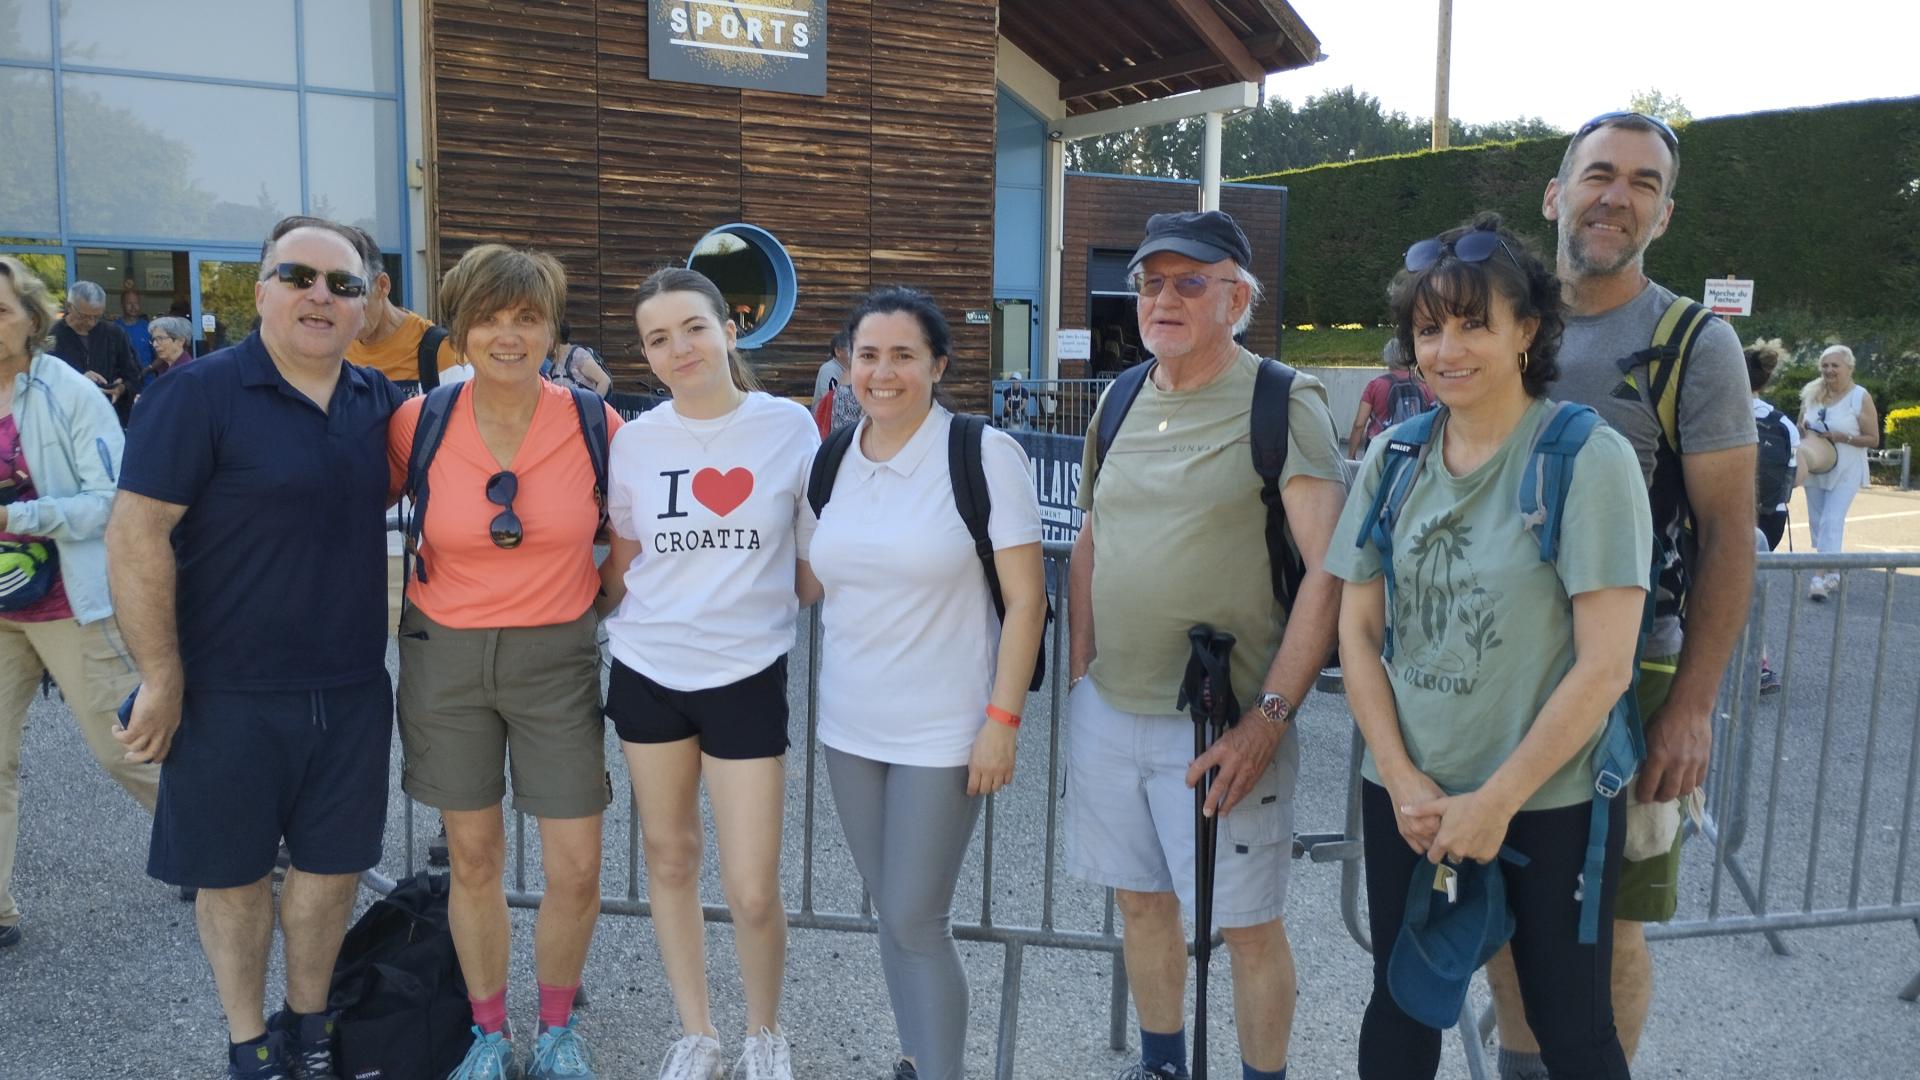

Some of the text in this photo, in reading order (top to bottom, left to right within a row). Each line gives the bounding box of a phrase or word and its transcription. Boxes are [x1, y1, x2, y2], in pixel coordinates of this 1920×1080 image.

[670, 7, 809, 48] SPORTS
[1708, 289, 1735, 297] Marche
[657, 469, 690, 519] I
[1030, 457, 1082, 507] ALAIS
[1040, 509, 1062, 519] UMENT
[654, 529, 760, 553] CROATIA
